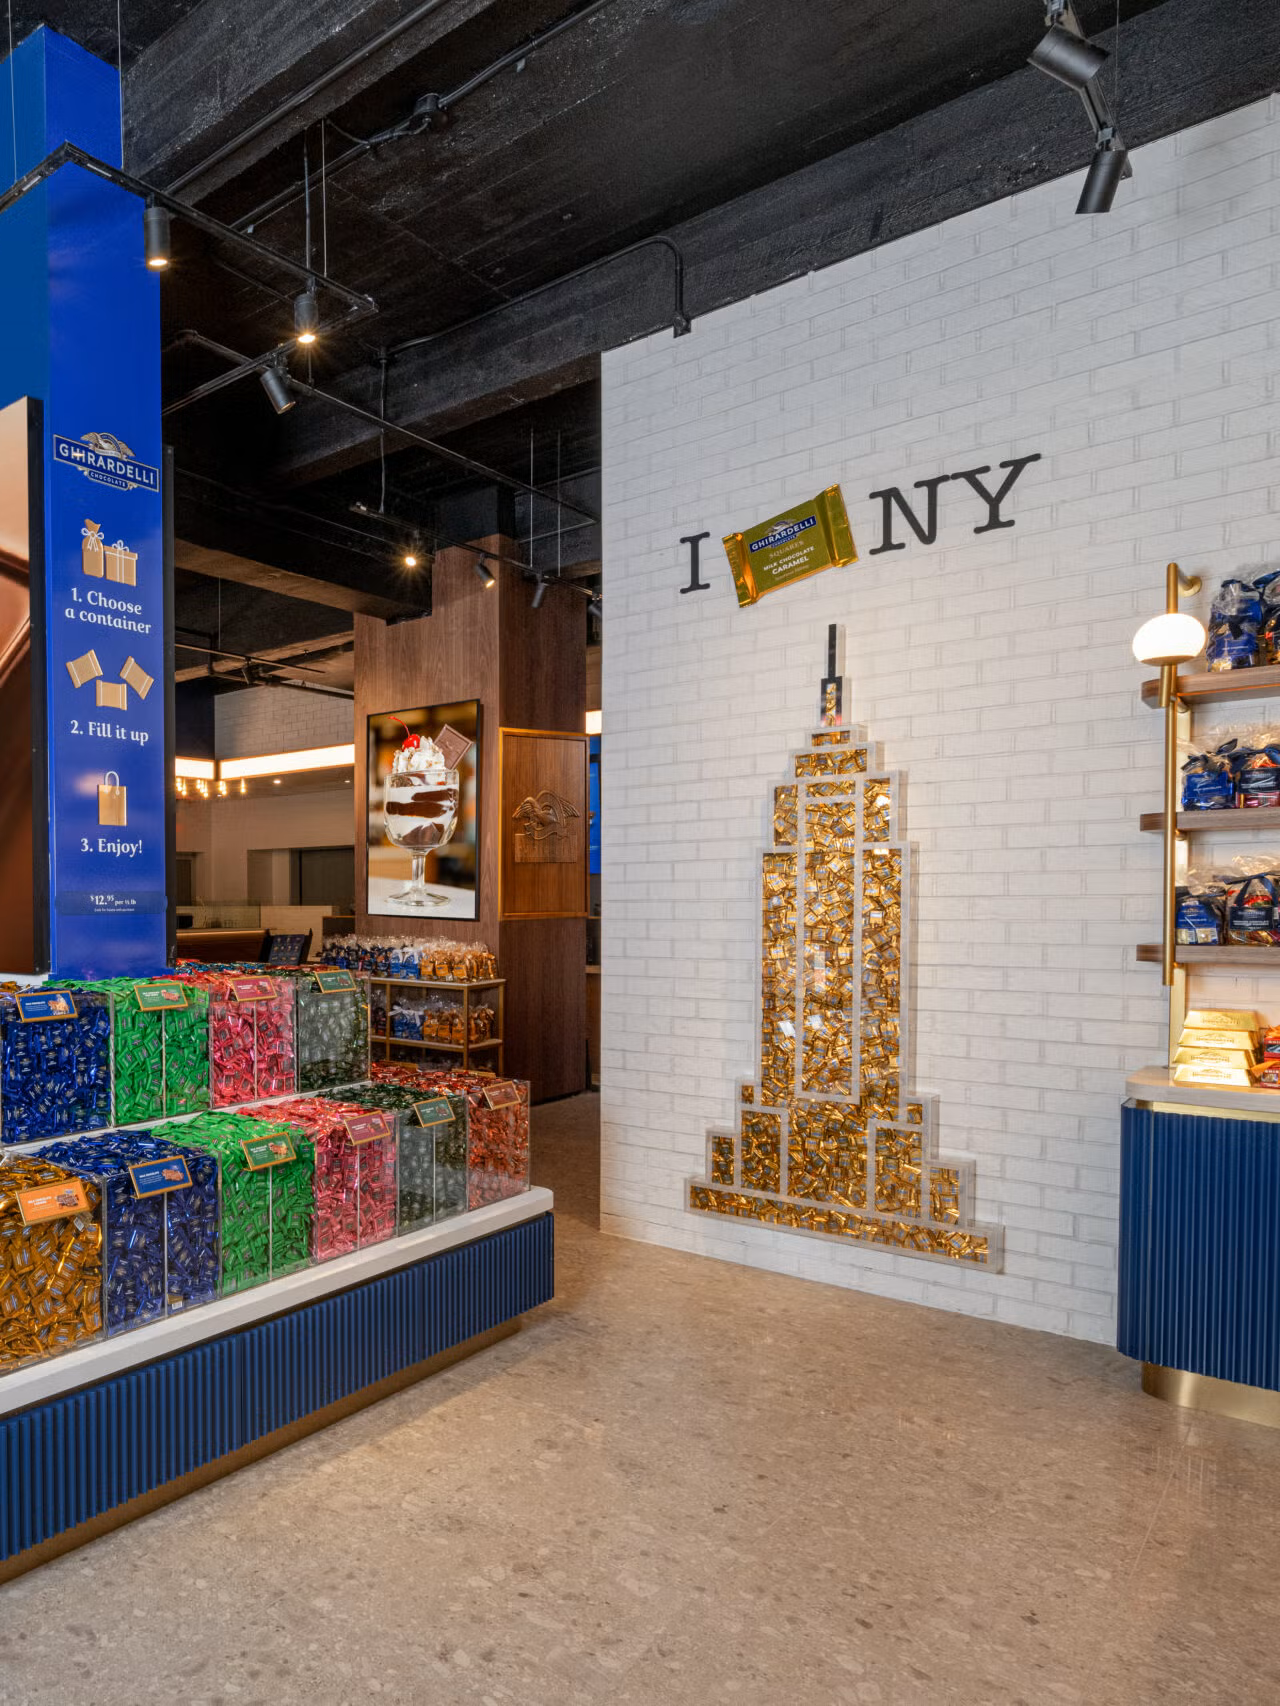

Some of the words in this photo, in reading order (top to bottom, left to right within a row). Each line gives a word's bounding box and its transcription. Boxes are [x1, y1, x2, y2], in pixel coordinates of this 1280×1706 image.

[59, 443, 154, 485] GHIRARDELLI
[90, 472, 126, 487] CHOCOLATE
[680, 532, 710, 594] I
[869, 453, 1041, 555] NY
[751, 518, 814, 550] GHIRARDELLI
[763, 562, 778, 571] MILK
[779, 546, 814, 563] CHOCOLATE
[772, 556, 809, 575] CARAMEL
[71, 587, 82, 603] 1.
[87, 590, 142, 615] Choose
[65, 608, 75, 619] a
[79, 610, 151, 634] container
[70, 720, 84, 735] 2.
[88, 722, 112, 738] Fill
[116, 725, 127, 740] it
[130, 730, 149, 746] up
[80, 838, 93, 852] 3.
[98, 839, 143, 857] Enjoy!
